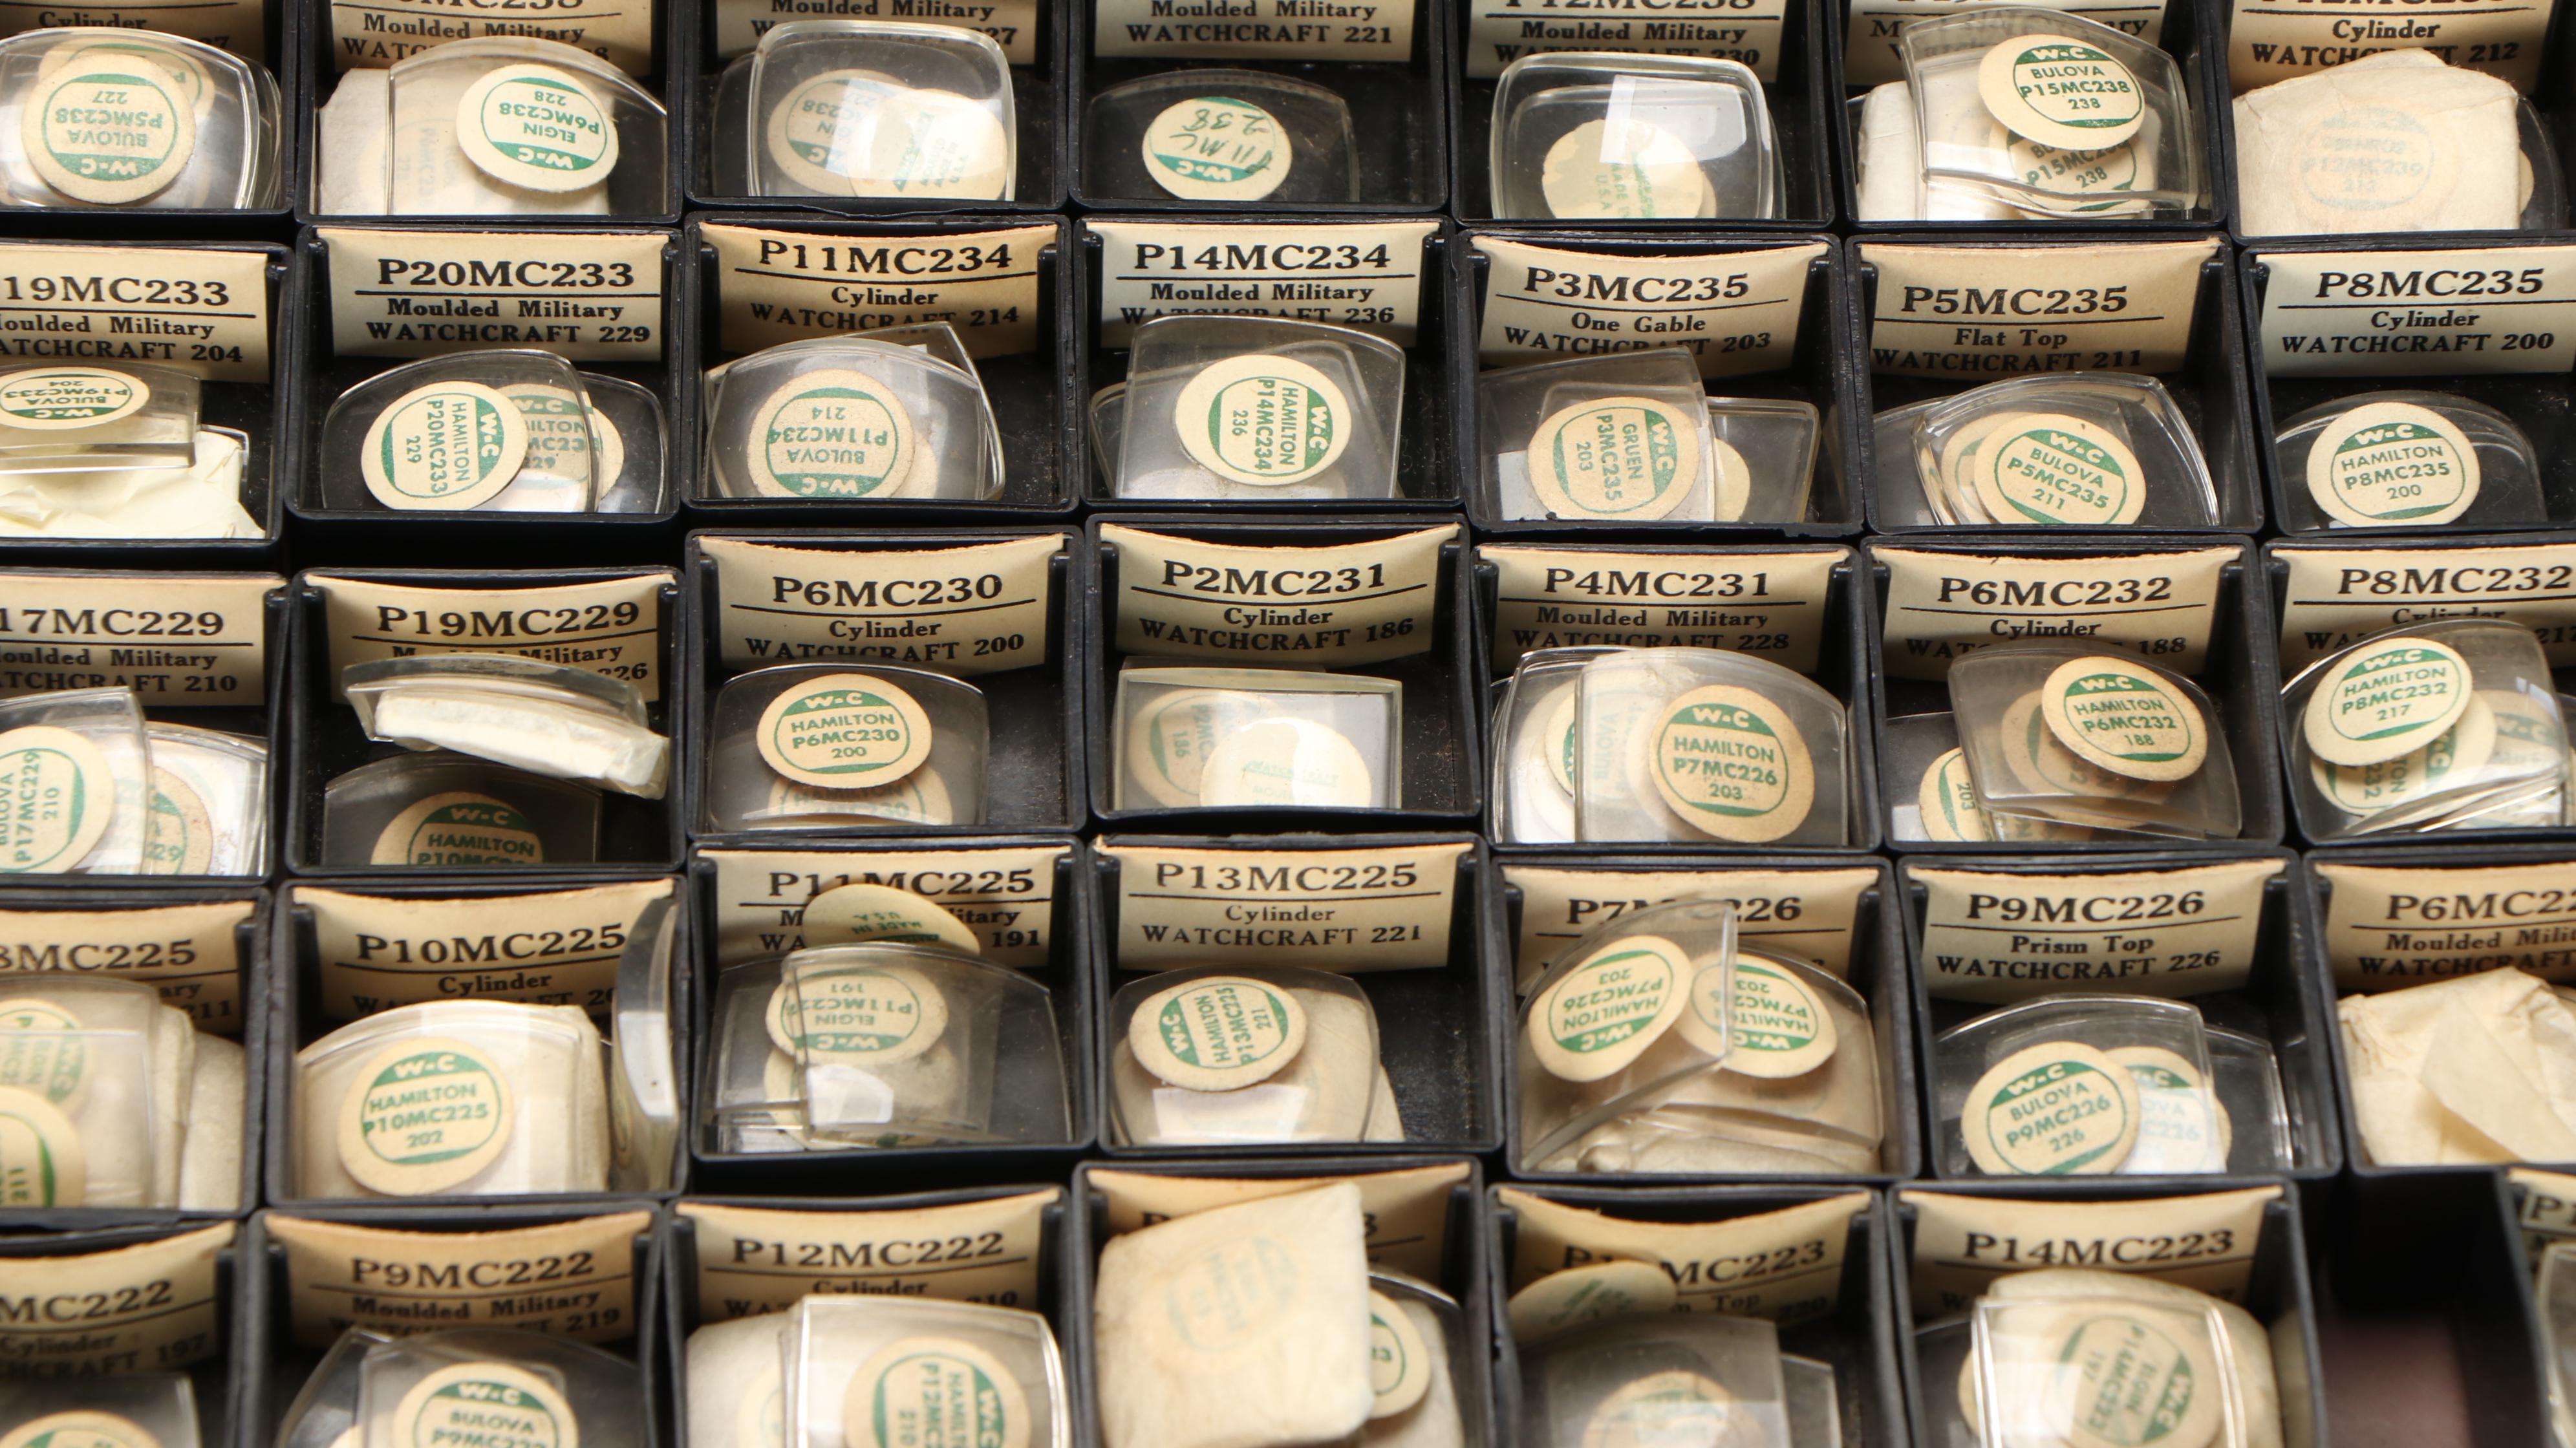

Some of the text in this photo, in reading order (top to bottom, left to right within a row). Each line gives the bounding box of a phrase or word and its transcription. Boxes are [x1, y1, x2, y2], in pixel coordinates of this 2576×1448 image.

[38, 12, 147, 30] Cylinder
[771, 0, 994, 21] Moulded Military
[1152, 0, 1377, 21] Moulded Military
[363, 14, 585, 43] Moulded Military
[1127, 25, 1392, 43] WATCHCRAFT 221
[1521, 21, 1747, 44] Moulded Military
[2332, 19, 2441, 43] Cylinder
[2467, 42, 2520, 63] 212
[2032, 65, 2105, 79] BULOVA
[91, 91, 127, 104] 227
[534, 90, 566, 105] 228
[2020, 80, 2131, 98] P15MC238
[2068, 98, 2101, 109] 238
[55, 107, 164, 128] P5MC238
[499, 102, 600, 134] P6MC238
[67, 129, 148, 148] BULOVA
[523, 122, 576, 144] ELGIN
[2076, 167, 2108, 188] 238
[759, 240, 1013, 275] P11MC234
[1135, 244, 1390, 270] P14MC234
[378, 259, 634, 287] P20MC233
[1524, 266, 1748, 302] P3MC235
[2315, 268, 2545, 297] P8MC235
[831, 286, 939, 307] Cylinder
[1151, 284, 1375, 302] Moulded Military
[1901, 286, 2128, 314] P5MC235
[387, 298, 623, 321] Moulded Military
[971, 306, 1019, 325] 214
[1344, 307, 1395, 323] 236
[2371, 310, 2480, 331] Cylinder
[110, 317, 215, 339] Military
[366, 323, 650, 343] WATCHCRAFT 229
[1571, 312, 1706, 333] One Gable
[1721, 332, 1771, 353] 203
[1954, 328, 2068, 349] Flat Top
[2282, 332, 2555, 354] WATCHCRAFT 200
[191, 345, 243, 363] 204
[1873, 348, 2141, 372] WATCHCRAFT 211
[3, 388, 128, 398] P19MC233
[27, 396, 107, 405] BULOVA
[812, 407, 846, 420] 214
[1232, 410, 1248, 436] 236
[1255, 378, 1276, 470] P14MC234
[768, 427, 888, 445] P11MC234
[1280, 388, 1298, 465] HAMILTON
[406, 435, 421, 464] 229
[427, 399, 447, 493] P20MC233
[451, 402, 471, 482] HAMILTON
[1622, 423, 1643, 480] GRUEN
[788, 450, 864, 465] BULOVA
[1576, 442, 1593, 472] 203
[1597, 414, 1624, 501] P3MC235
[2029, 447, 2105, 489] BULOVA
[2341, 444, 2443, 471] HAMILTON
[2006, 457, 2110, 509] P5MC235
[2344, 462, 2451, 491] P8MC235
[2032, 489, 2066, 511] 211
[2386, 484, 2422, 500] 200
[1162, 560, 1385, 596] P2MC231
[1544, 568, 1769, 597] P4MC231
[2338, 566, 2571, 595] P8MC232
[773, 575, 1003, 607] P6MC230
[1938, 577, 2172, 606] P6MC232
[376, 601, 639, 637] P19MC229
[1223, 608, 1333, 628] Cylinder
[1536, 606, 1768, 628] Moulded Military
[829, 621, 941, 641] Cylinder
[1139, 618, 1414, 650] WATCHCRAFT 186
[1990, 619, 2101, 640] Cylinder
[973, 634, 1024, 657] 200
[1737, 634, 1789, 650] 228
[2138, 637, 2187, 655] 188
[109, 650, 218, 670] Military
[185, 675, 237, 692] 210
[2345, 667, 2447, 697] HAMILTON
[2074, 699, 2165, 716] HAMILTON
[2342, 683, 2448, 716] P8MC232
[791, 712, 895, 732] HAMILTON
[2377, 704, 2411, 721] 217
[2083, 716, 2176, 733] P6MC232
[793, 729, 900, 749] P6MC230
[2125, 734, 2155, 747] 188
[830, 747, 866, 760] 200
[1673, 738, 1774, 763] HAMILTON
[1673, 758, 1777, 786] P7MC226
[1708, 784, 1743, 800] 203
[14, 751, 43, 862] P17MC229
[42, 787, 60, 820] 210
[427, 833, 535, 857] HAMILTON
[1156, 862, 1418, 891] P13MC225
[1225, 905, 1335, 924] Cylinder
[1966, 891, 2205, 923] P9MC226
[356, 923, 626, 963] P10MC225
[991, 930, 1040, 948] 191
[1142, 924, 1421, 946] WATCHCRAFT 221
[2011, 935, 2154, 954] Prism Top
[2386, 932, 2502, 952] Moulded
[1937, 951, 2220, 980] WATCHCRAFT 226
[438, 972, 552, 997] Cylinder
[1598, 968, 1633, 986] 203
[831, 983, 864, 995] 191
[1563, 977, 1664, 1012] P7MC226
[815, 1015, 875, 1026] ELGIN
[1251, 1008, 1272, 1030] 221
[1563, 997, 1659, 1030] HAMILTON
[1194, 996, 1232, 1064] HAMILTON
[1216, 986, 1255, 1066] P13MC225
[369, 1083, 477, 1114] HAMILTON
[2010, 1081, 2090, 1121] BULOVA
[363, 1103, 489, 1135] P10MC225
[2005, 1094, 2112, 1148] P9MC226
[406, 1130, 444, 1149] 202
[2048, 1129, 2087, 1152] 226
[732, 1231, 1004, 1268] P12MC222
[1963, 1230, 2234, 1266] P14MC223
[351, 1252, 596, 1290] P9MC222
[351, 1292, 602, 1319] Moulded Military
[450, 1412, 535, 1434] BULOVA
